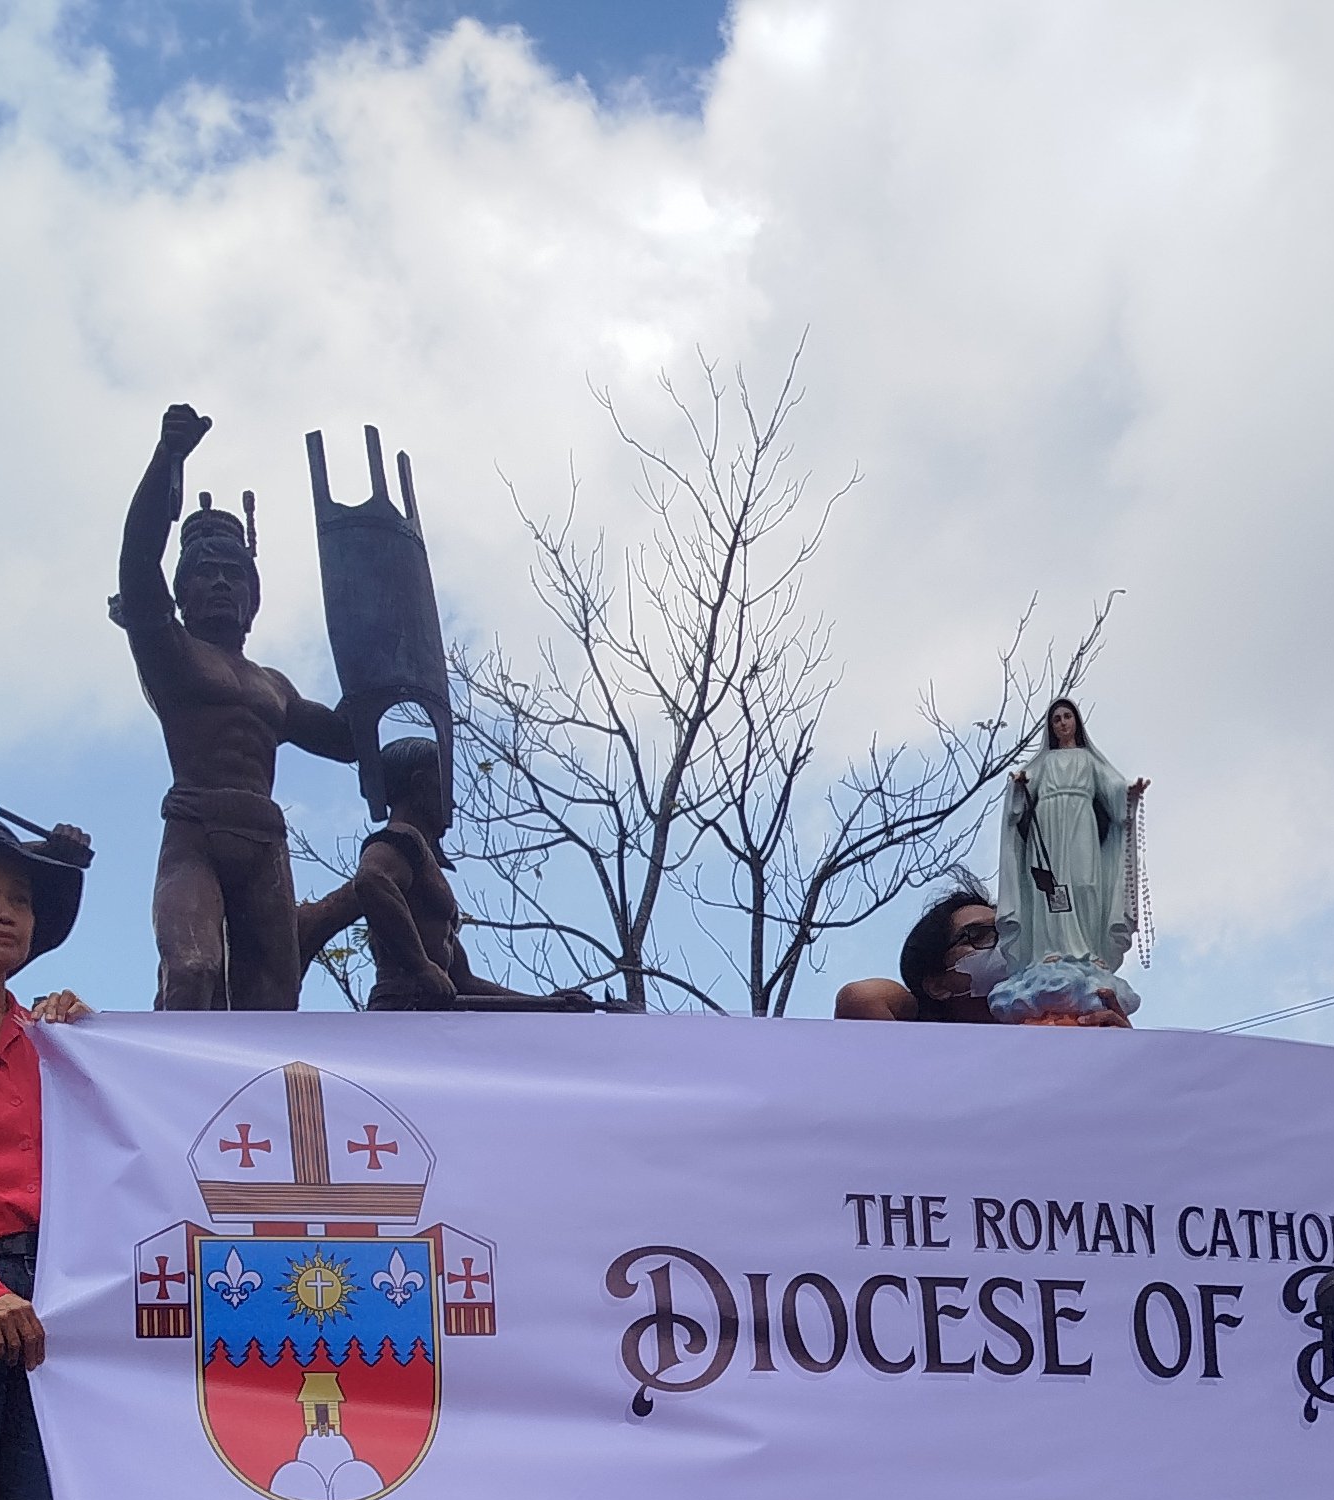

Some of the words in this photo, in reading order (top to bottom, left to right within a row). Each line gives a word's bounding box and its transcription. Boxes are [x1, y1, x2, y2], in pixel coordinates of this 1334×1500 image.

[843, 1192, 952, 1250] THE
[971, 1196, 1157, 1256] ROMAN
[604, 1244, 1094, 1419] DIOCESE
[1132, 1280, 1246, 1381] OF
